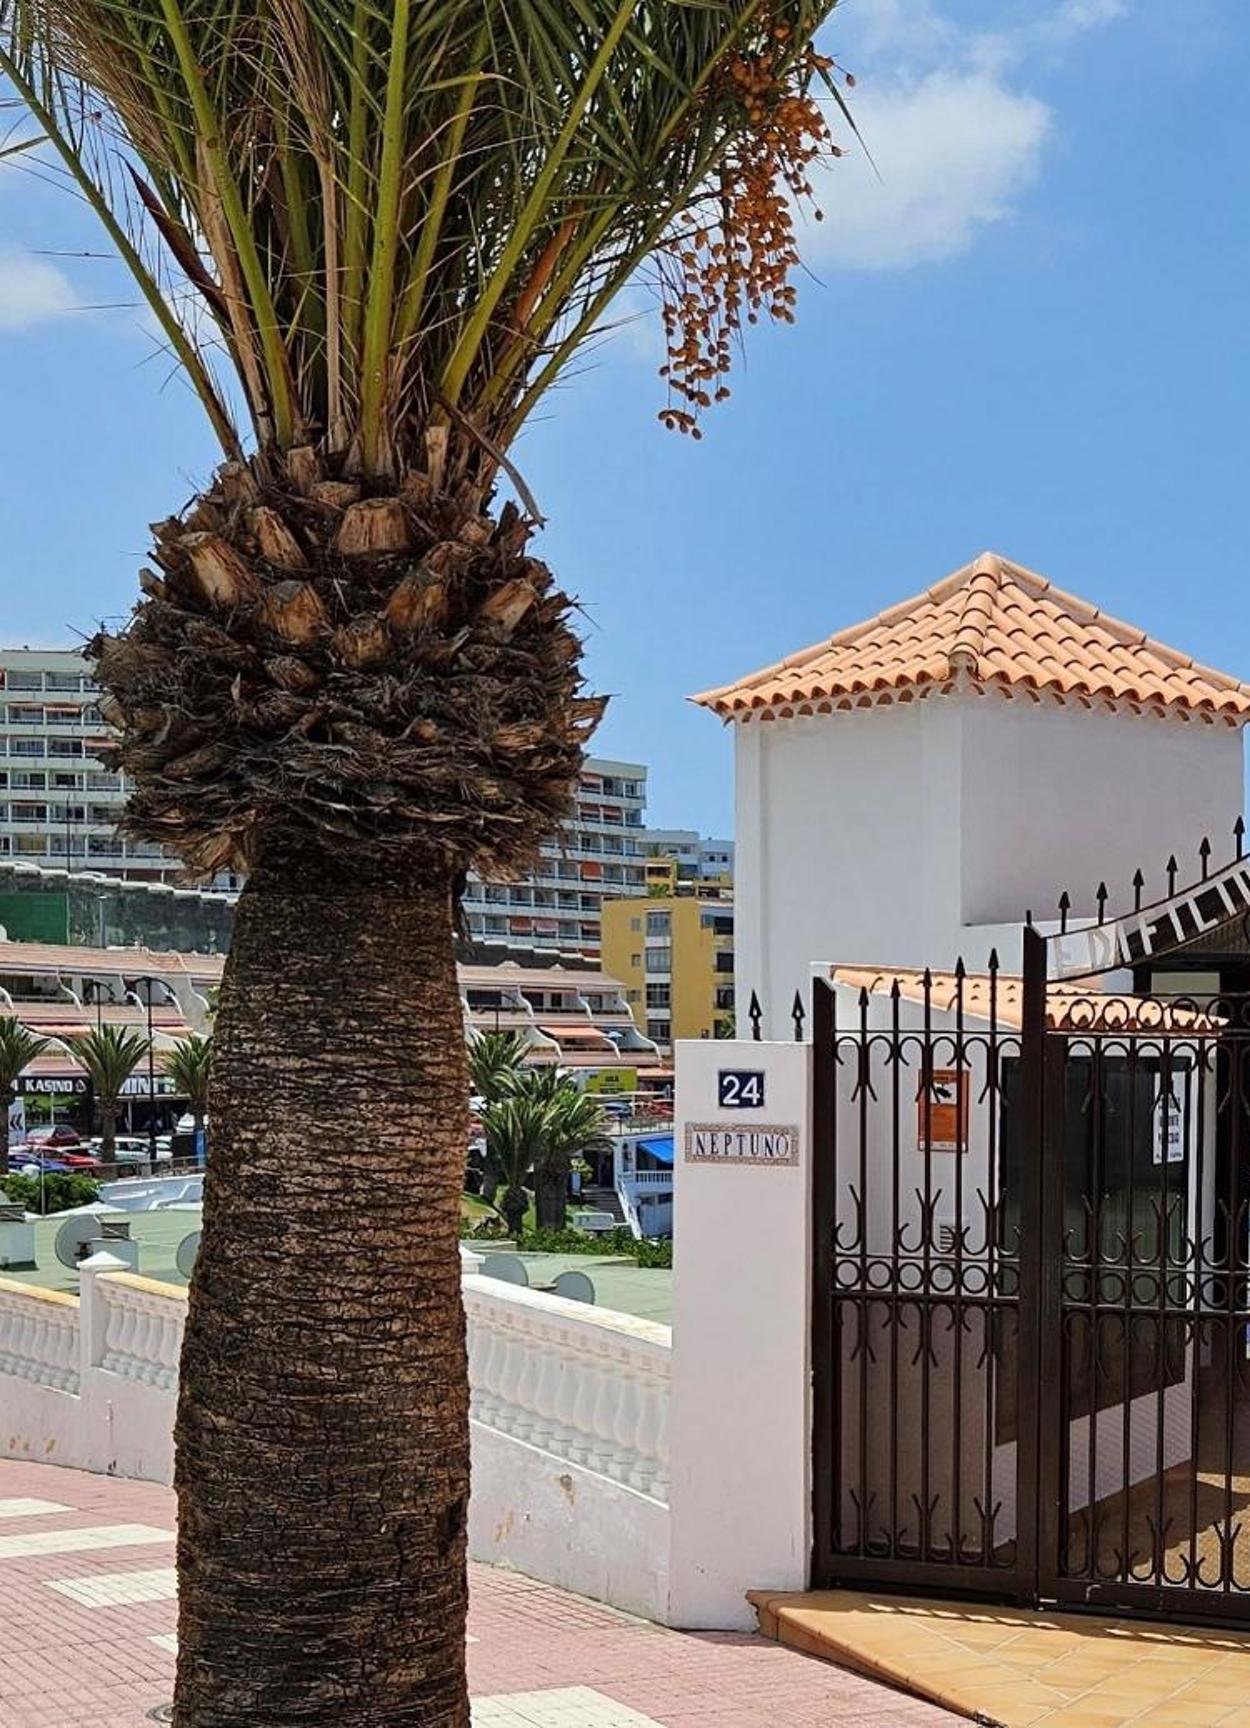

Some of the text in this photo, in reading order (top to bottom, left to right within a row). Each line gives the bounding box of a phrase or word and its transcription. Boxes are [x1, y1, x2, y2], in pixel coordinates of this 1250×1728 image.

[24, 1079, 73, 1093] KASINO
[723, 1075, 760, 1105] 24
[696, 1133, 789, 1157] NEPTUNO
